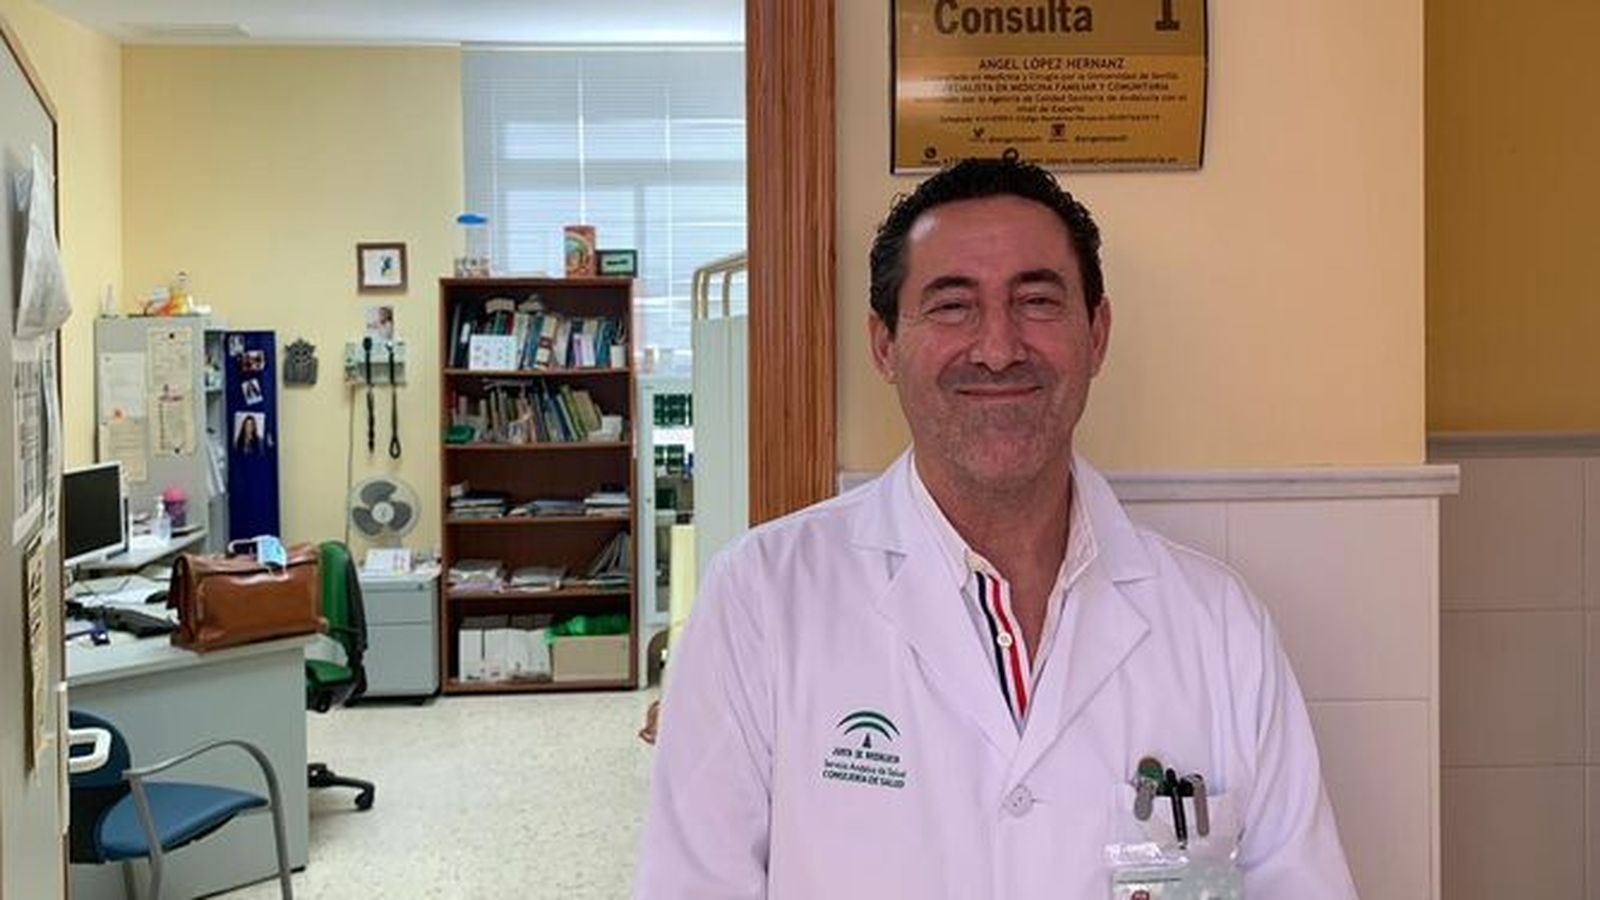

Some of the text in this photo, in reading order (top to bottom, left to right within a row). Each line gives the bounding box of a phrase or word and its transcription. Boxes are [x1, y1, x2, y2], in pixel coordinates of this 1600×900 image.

[934, 0, 1180, 35] Consulta 1
[1023, 56, 1062, 71] LÓPEZ
[1066, 57, 1125, 70] HERNANZ
